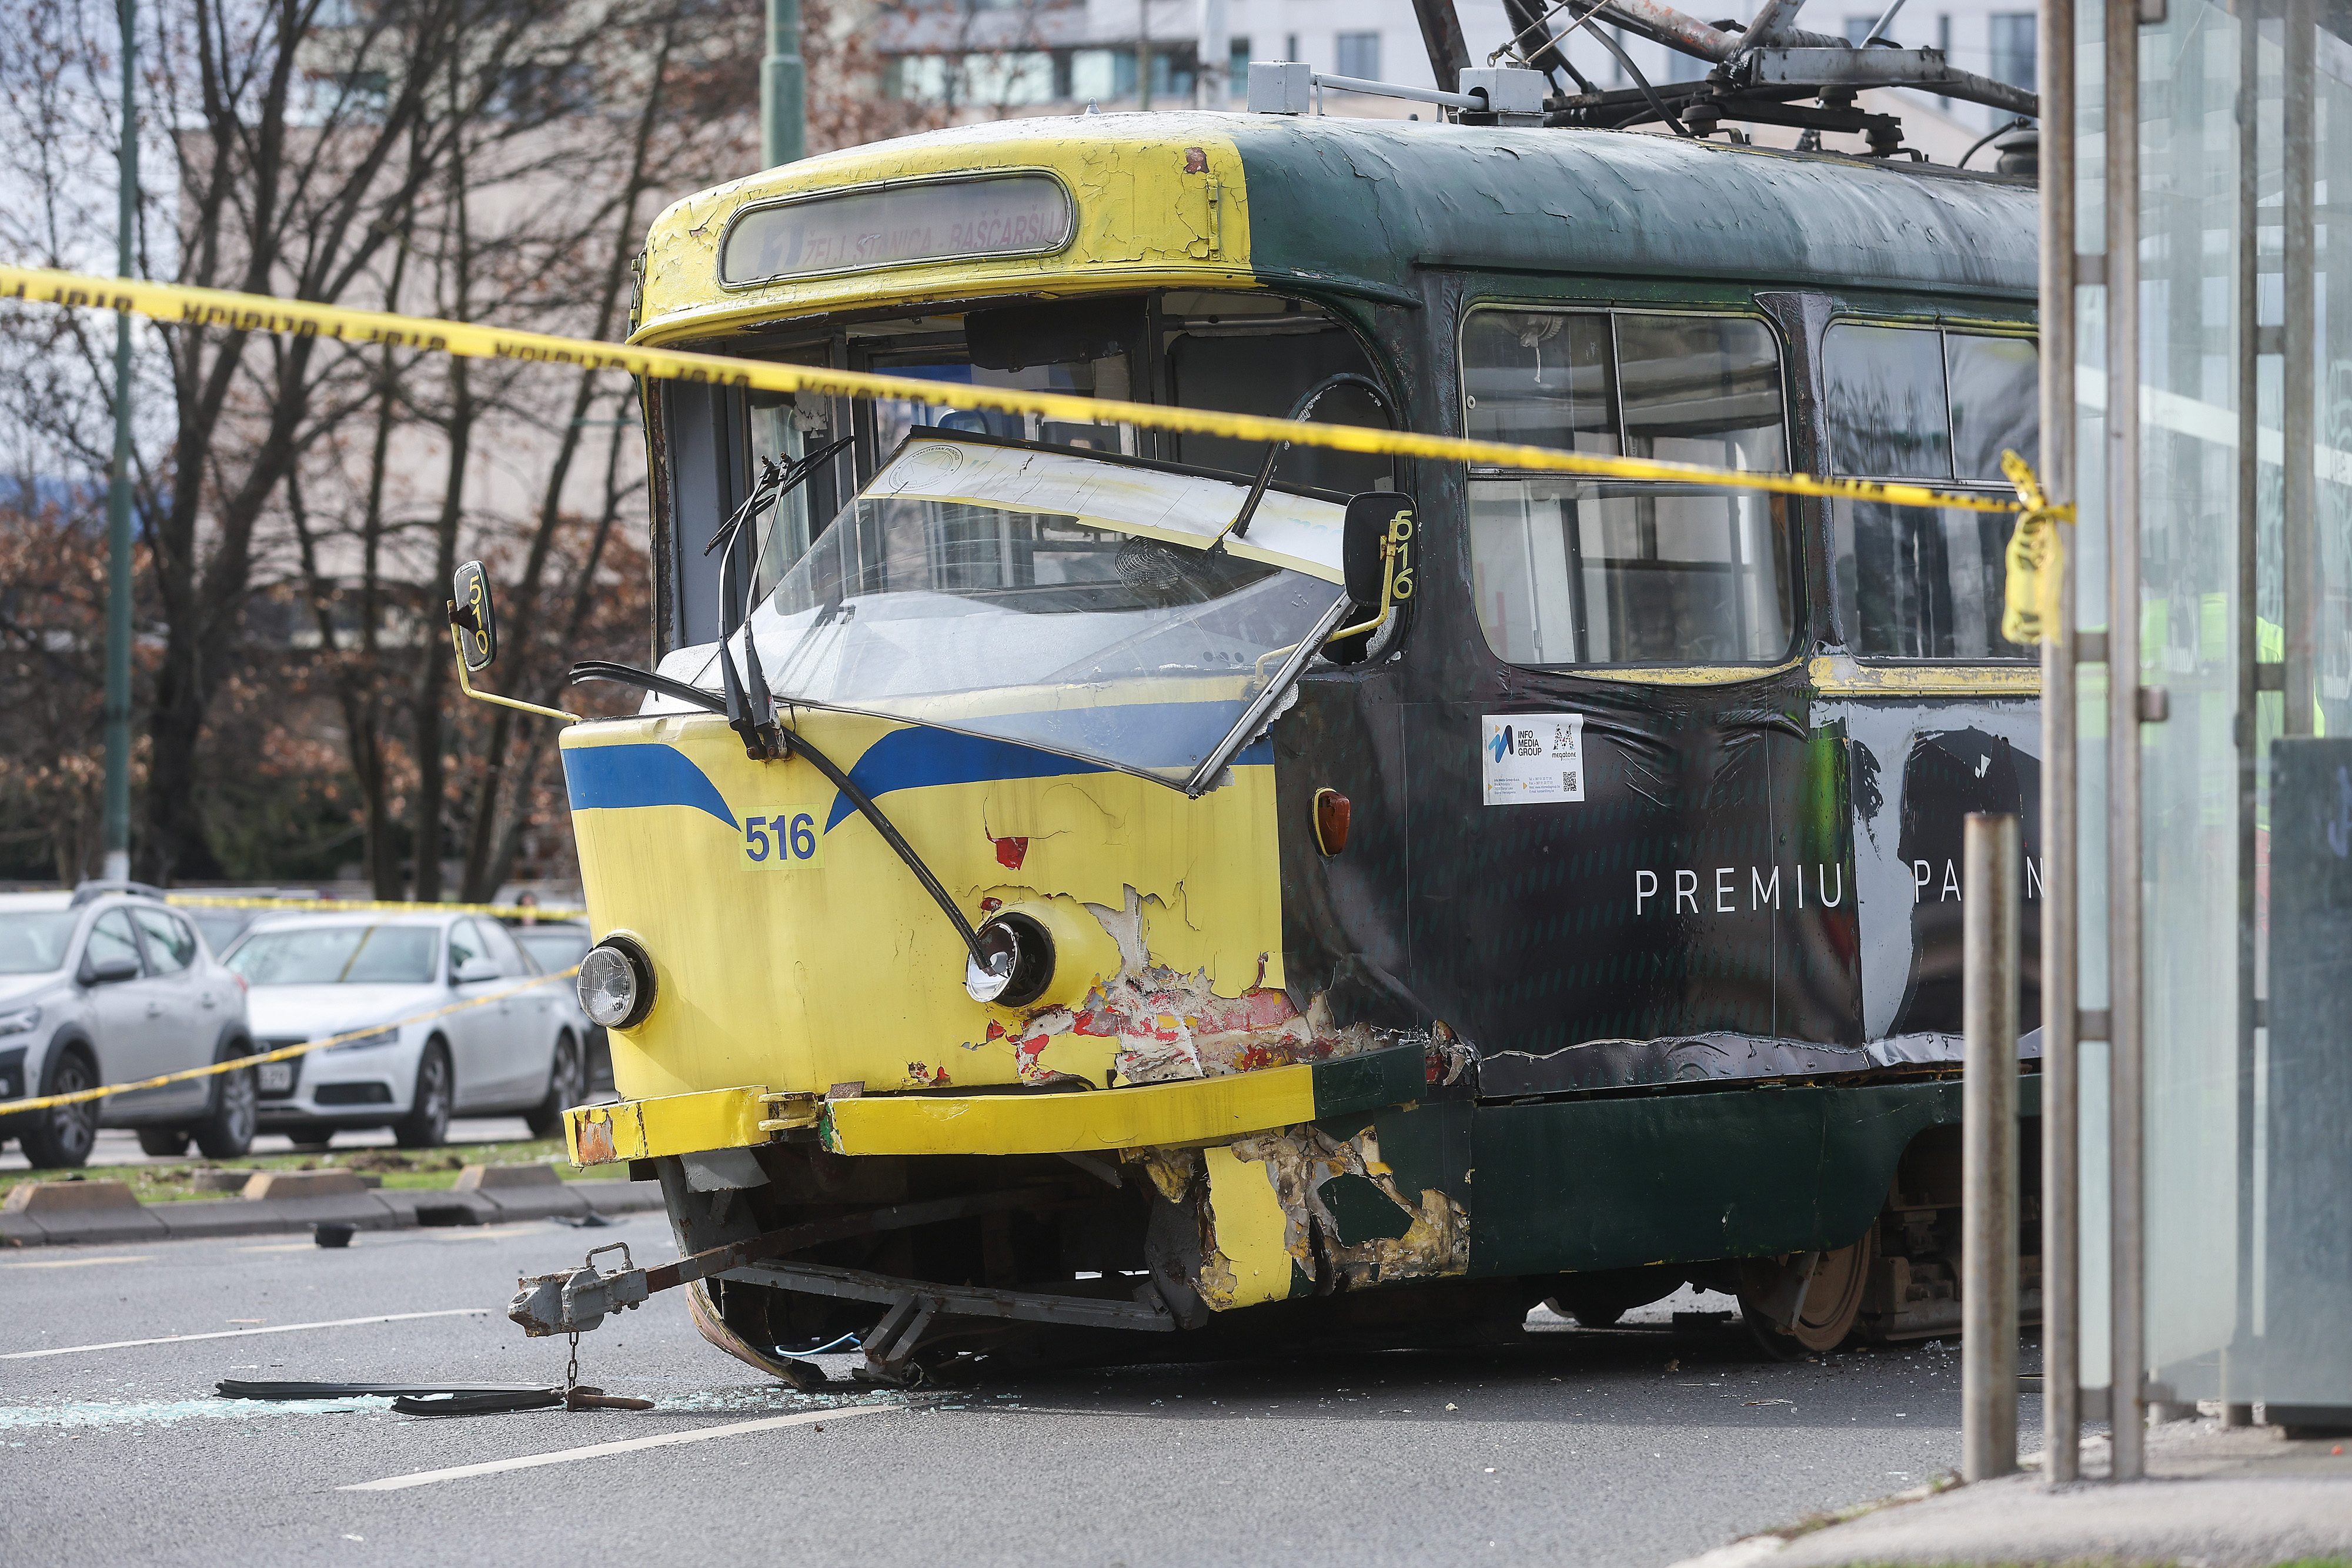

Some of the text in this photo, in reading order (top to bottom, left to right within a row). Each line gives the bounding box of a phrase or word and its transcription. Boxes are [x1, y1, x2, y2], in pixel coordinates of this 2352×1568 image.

[912, 447, 960, 460] KVALITETAN PROIZVOD
[1518, 730, 1533, 738] INFO
[1518, 739, 1539, 747] MEDIA
[1518, 748, 1542, 756] GROUP
[746, 813, 816, 862] 516
[1635, 862, 1842, 916] PREMIU
